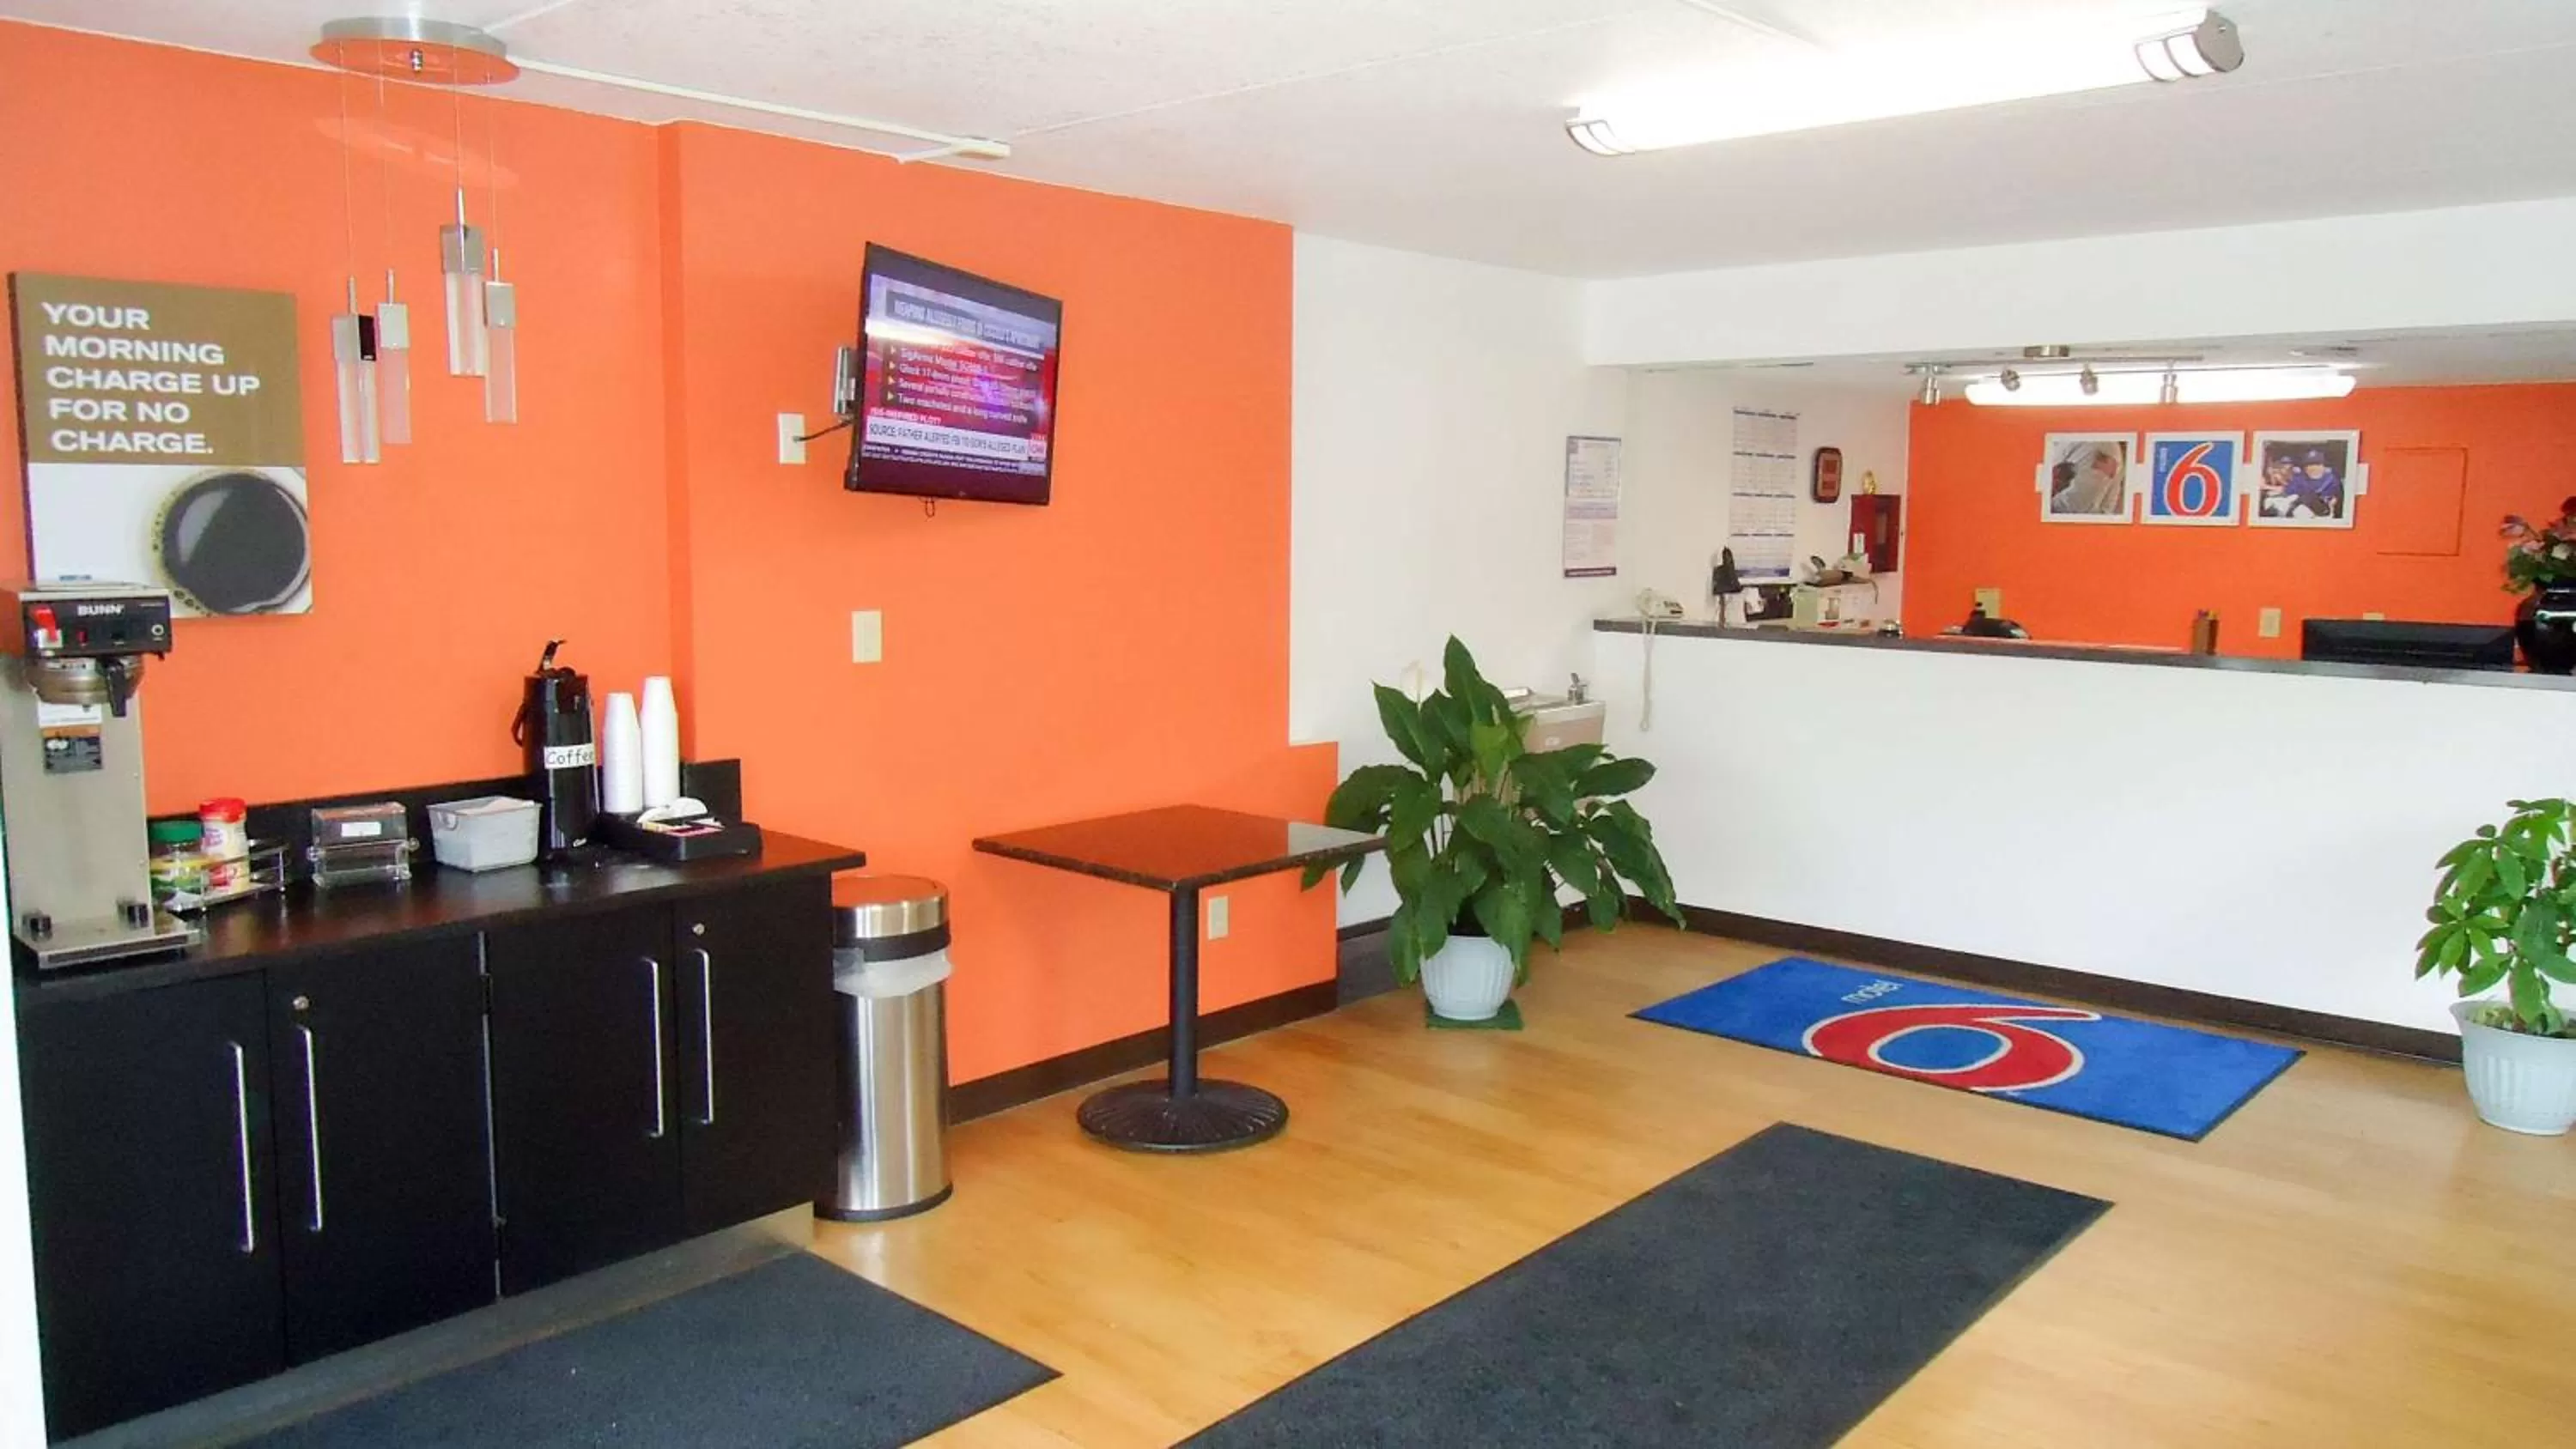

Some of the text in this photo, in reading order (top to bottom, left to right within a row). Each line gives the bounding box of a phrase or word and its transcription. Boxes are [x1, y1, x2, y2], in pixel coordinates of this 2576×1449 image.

[42, 302, 150, 330] YOUR
[46, 335, 224, 364] MORNING
[46, 367, 260, 395] CHARGE UP
[49, 398, 191, 423] FOR NO
[51, 429, 213, 454] CHARGE.
[2165, 442, 2222, 518] 6
[77, 604, 122, 616] BUNN
[546, 748, 595, 766] Coffee
[1840, 979, 1904, 1004] motel
[1802, 1003, 2103, 1092] 6
